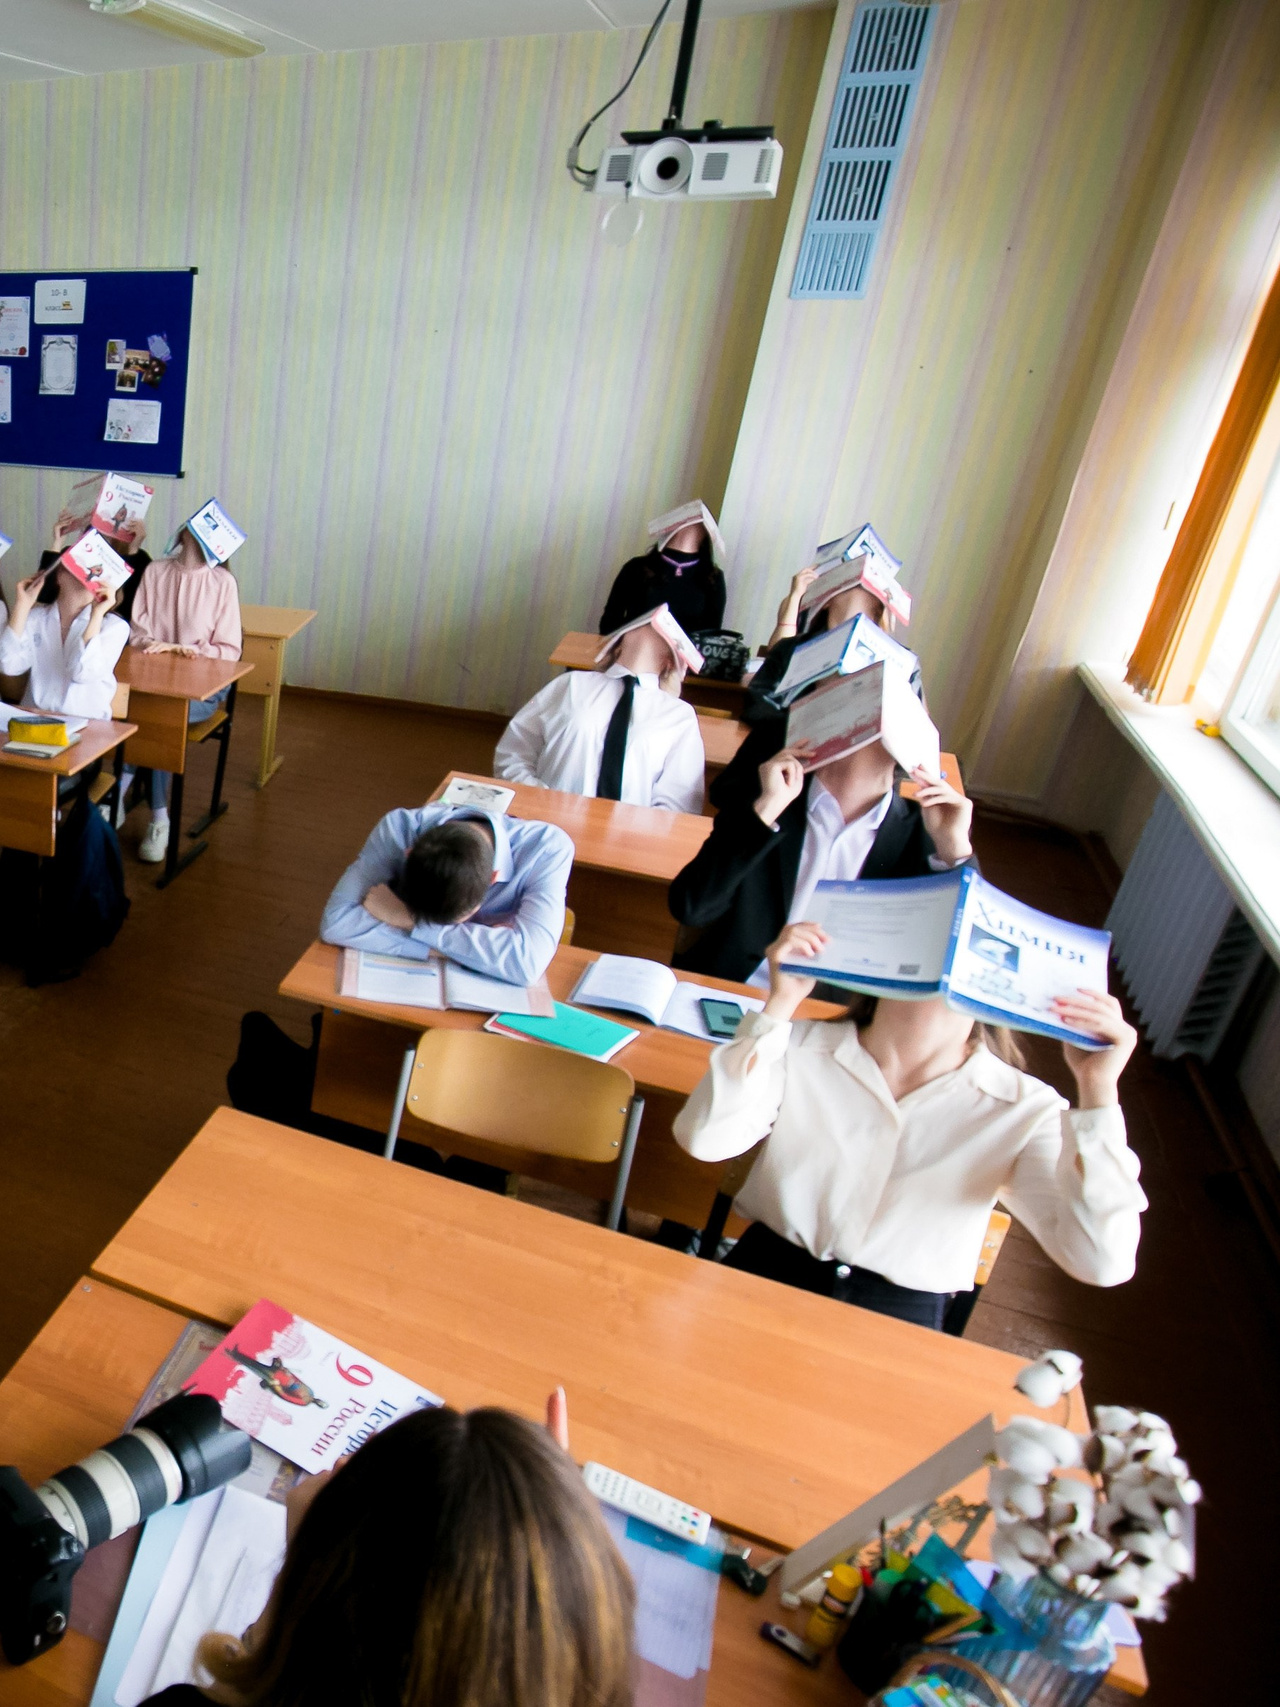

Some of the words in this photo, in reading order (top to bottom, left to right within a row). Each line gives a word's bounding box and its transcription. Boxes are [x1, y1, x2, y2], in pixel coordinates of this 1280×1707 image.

[105, 491, 114, 502] 9
[973, 899, 1087, 966] Химия
[335, 1352, 374, 1387] 9
[311, 1397, 367, 1456] России
